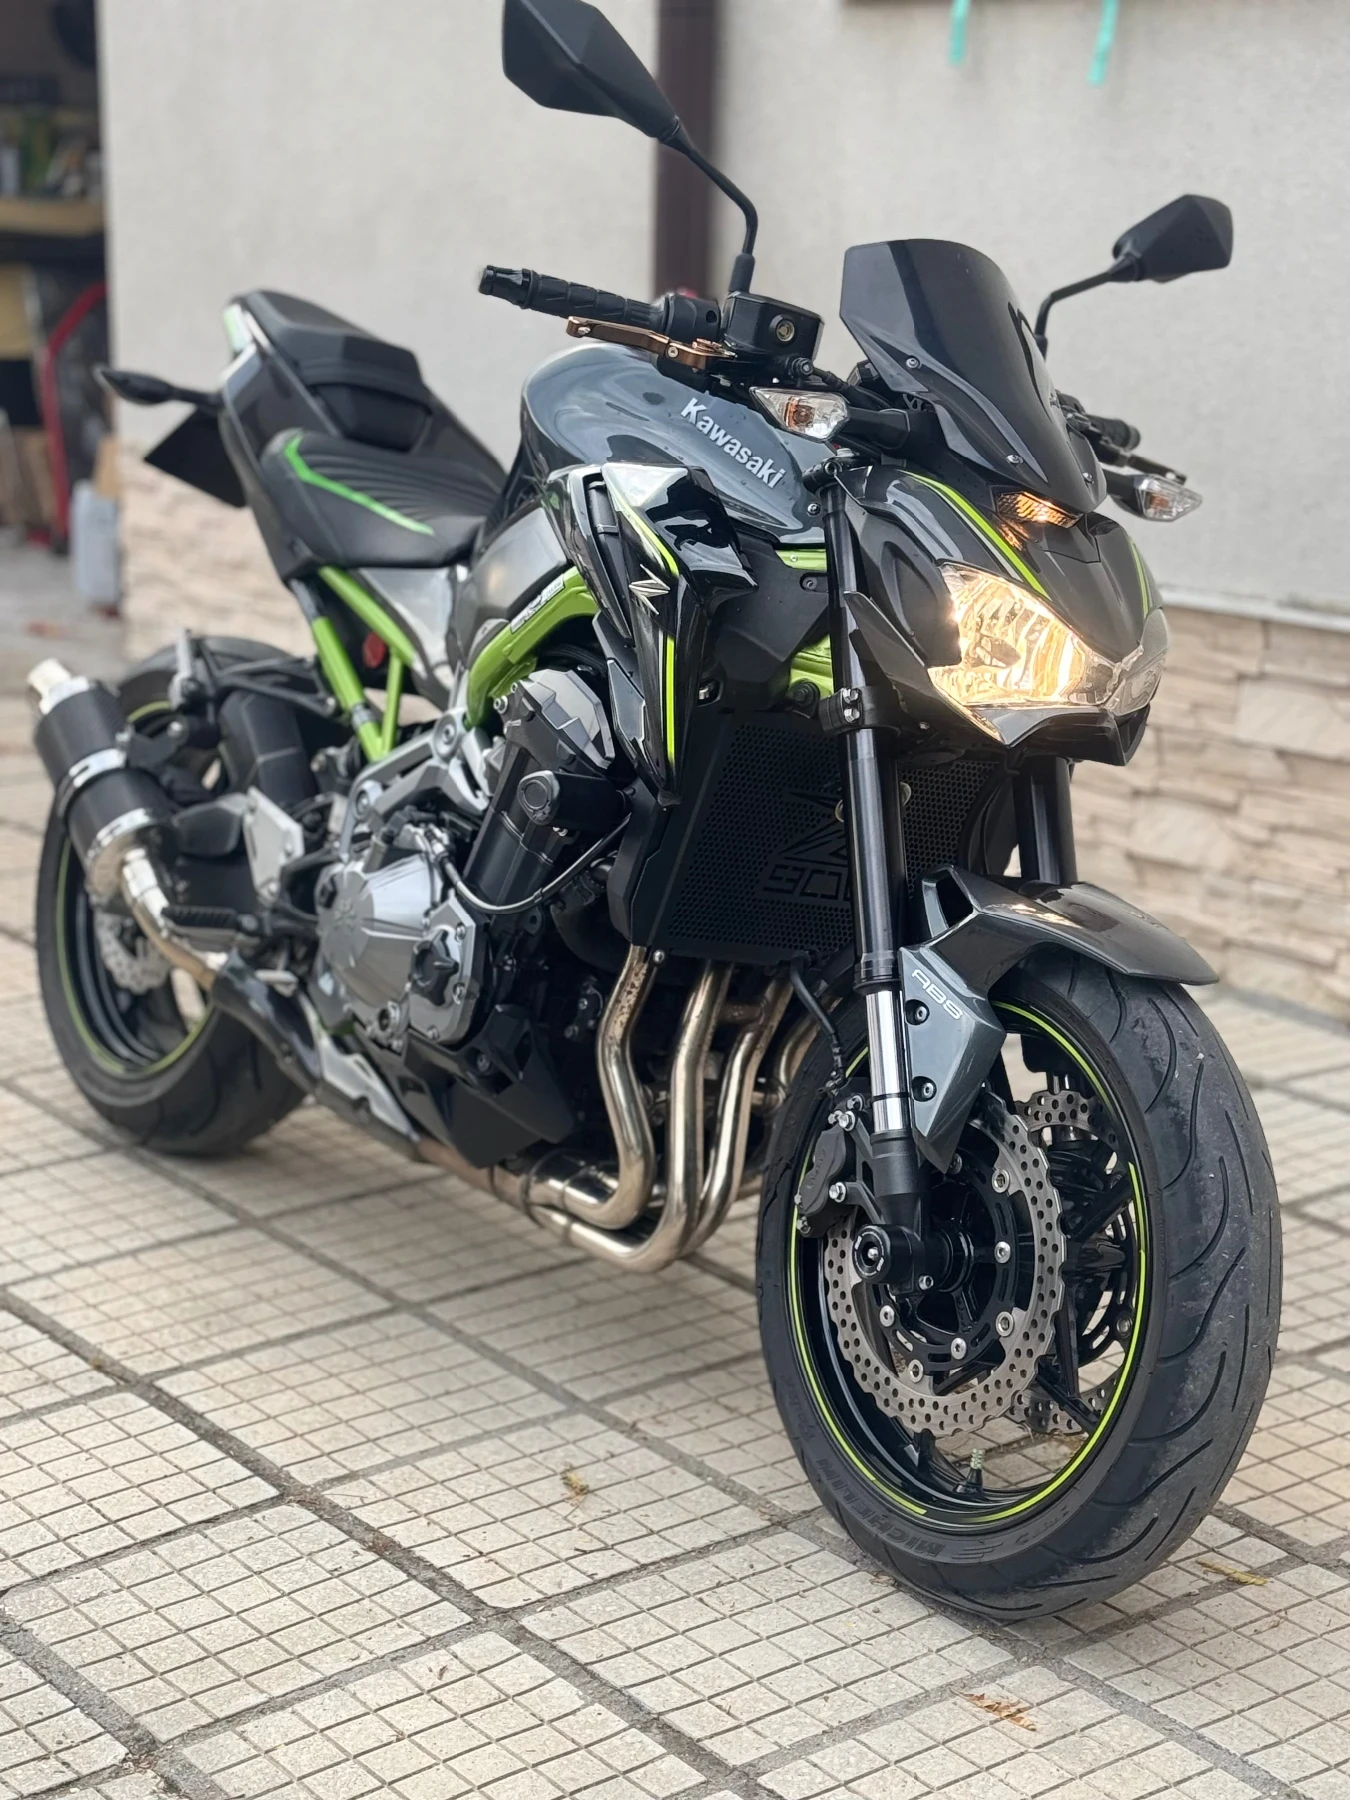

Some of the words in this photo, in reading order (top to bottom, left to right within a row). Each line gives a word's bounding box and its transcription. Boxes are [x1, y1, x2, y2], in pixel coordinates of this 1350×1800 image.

[680, 397, 786, 489] Kawasaki
[911, 969, 963, 1020] ABS
[816, 1457, 946, 1558] MICHELIN
